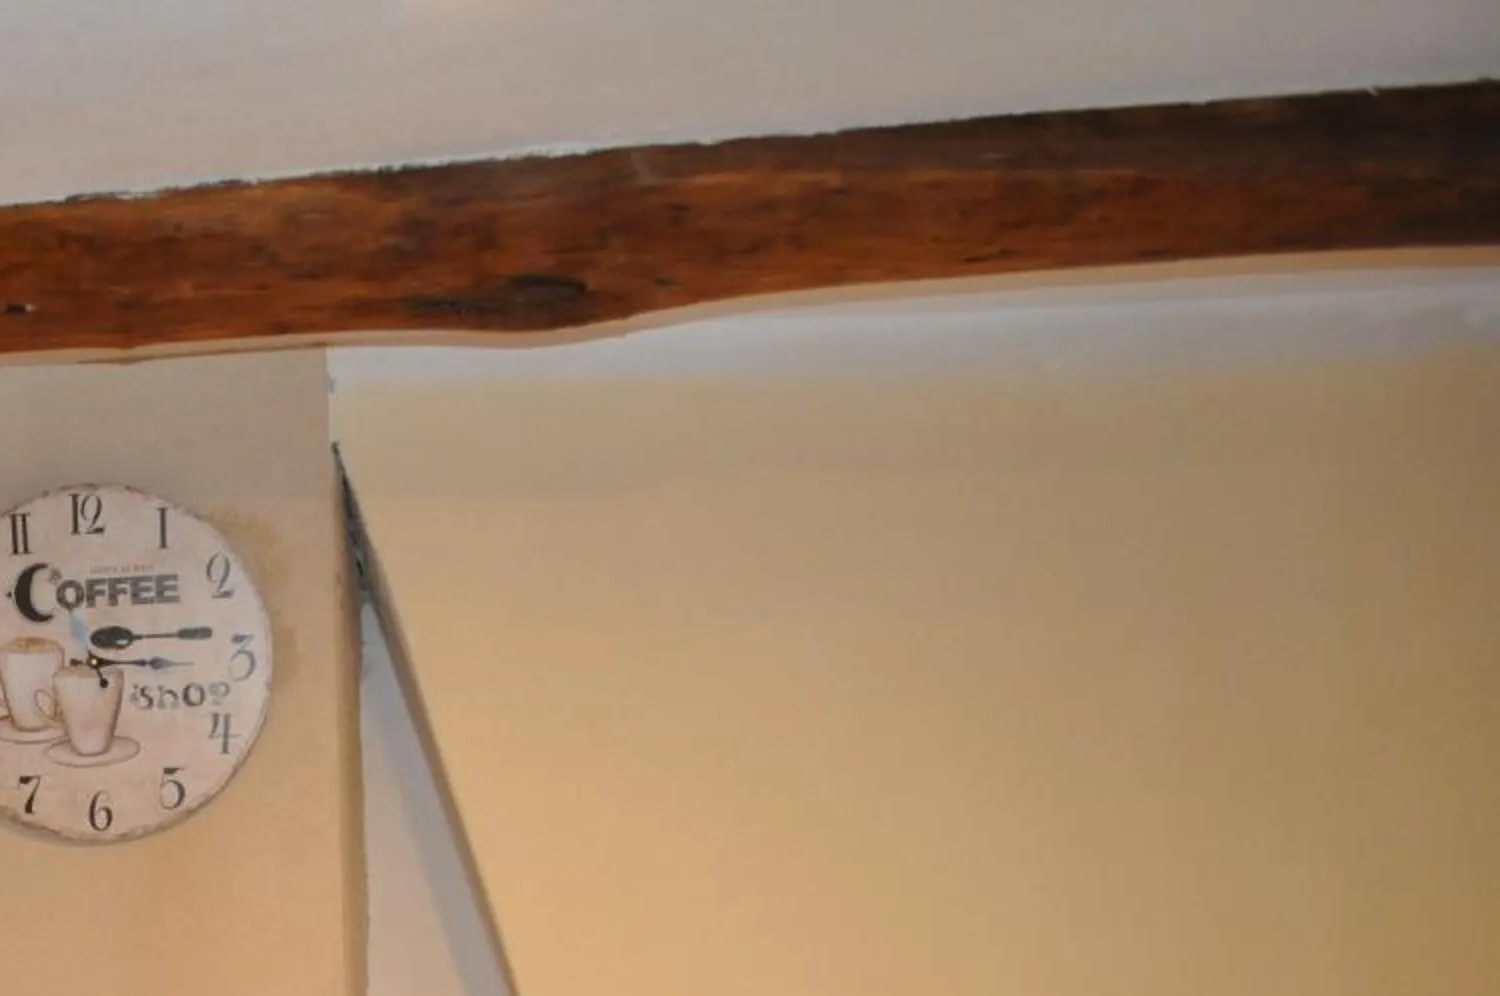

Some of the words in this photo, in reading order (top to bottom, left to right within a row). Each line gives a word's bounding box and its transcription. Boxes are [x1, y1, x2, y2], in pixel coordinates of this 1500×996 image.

[69, 493, 105, 535] 12
[157, 507, 169, 549] 1
[14, 563, 180, 623] COFFEE
[206, 552, 234, 598] 2
[230, 634, 256, 682] 3
[208, 712, 239, 754] 4
[19, 775, 41, 815] 7
[159, 767, 186, 810] 5
[88, 791, 113, 832] 6
